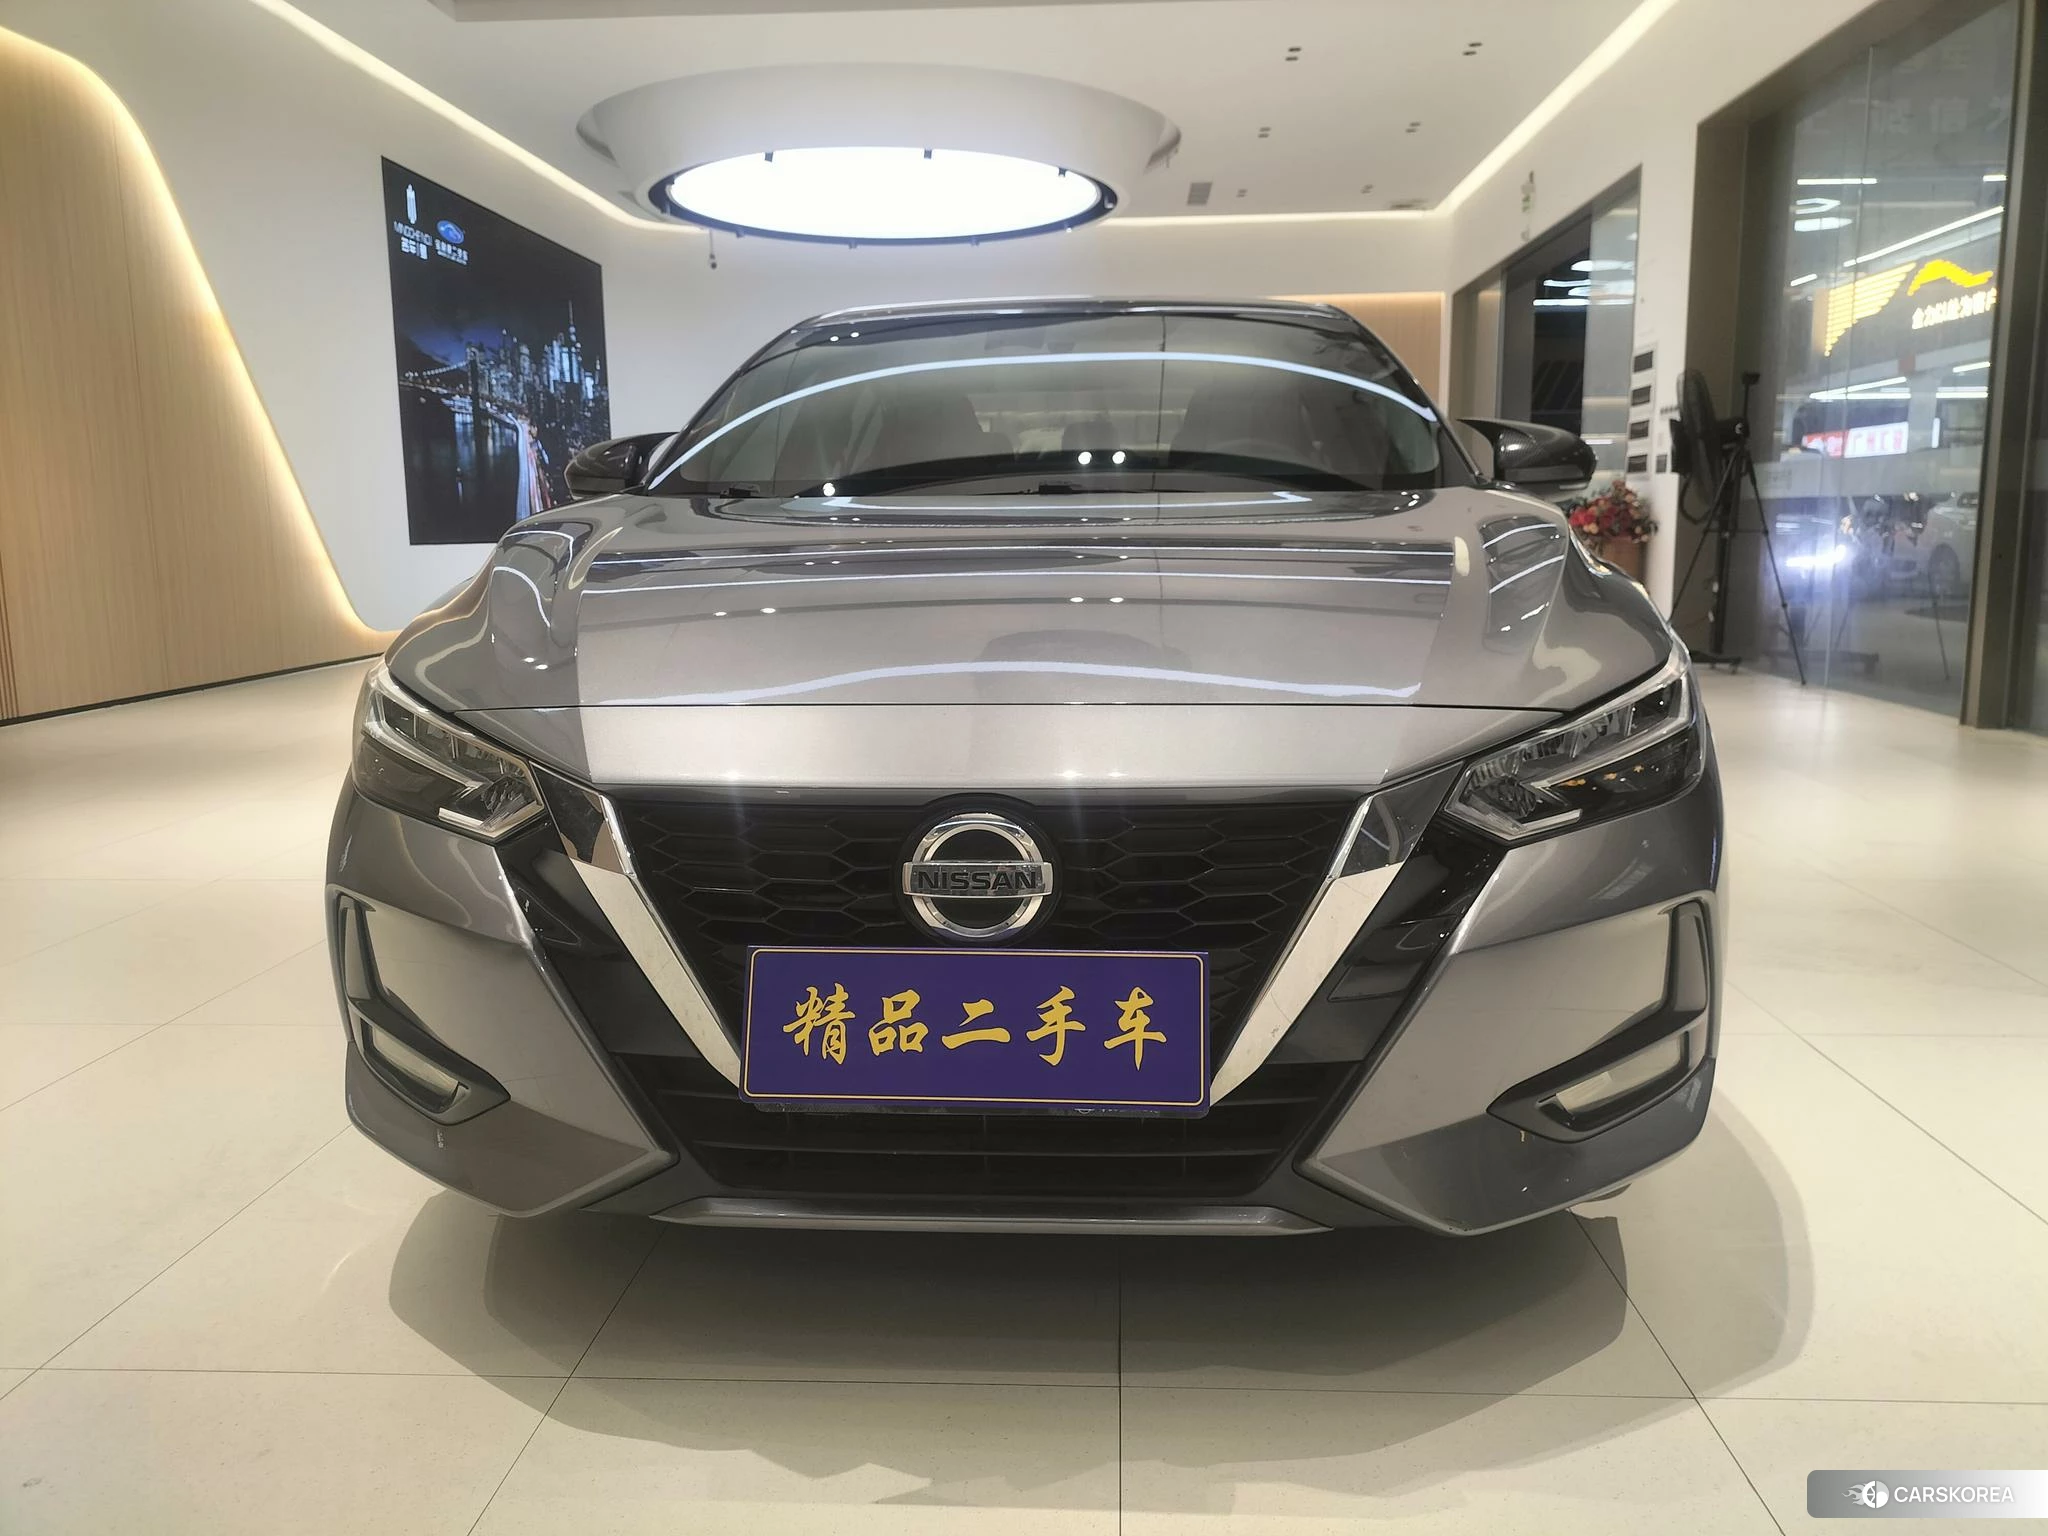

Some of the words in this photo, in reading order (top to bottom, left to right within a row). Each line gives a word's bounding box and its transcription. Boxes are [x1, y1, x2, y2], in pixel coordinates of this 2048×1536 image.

[917, 870, 1037, 890] NISSAN
[782, 982, 1168, 1071] 精品二手车
